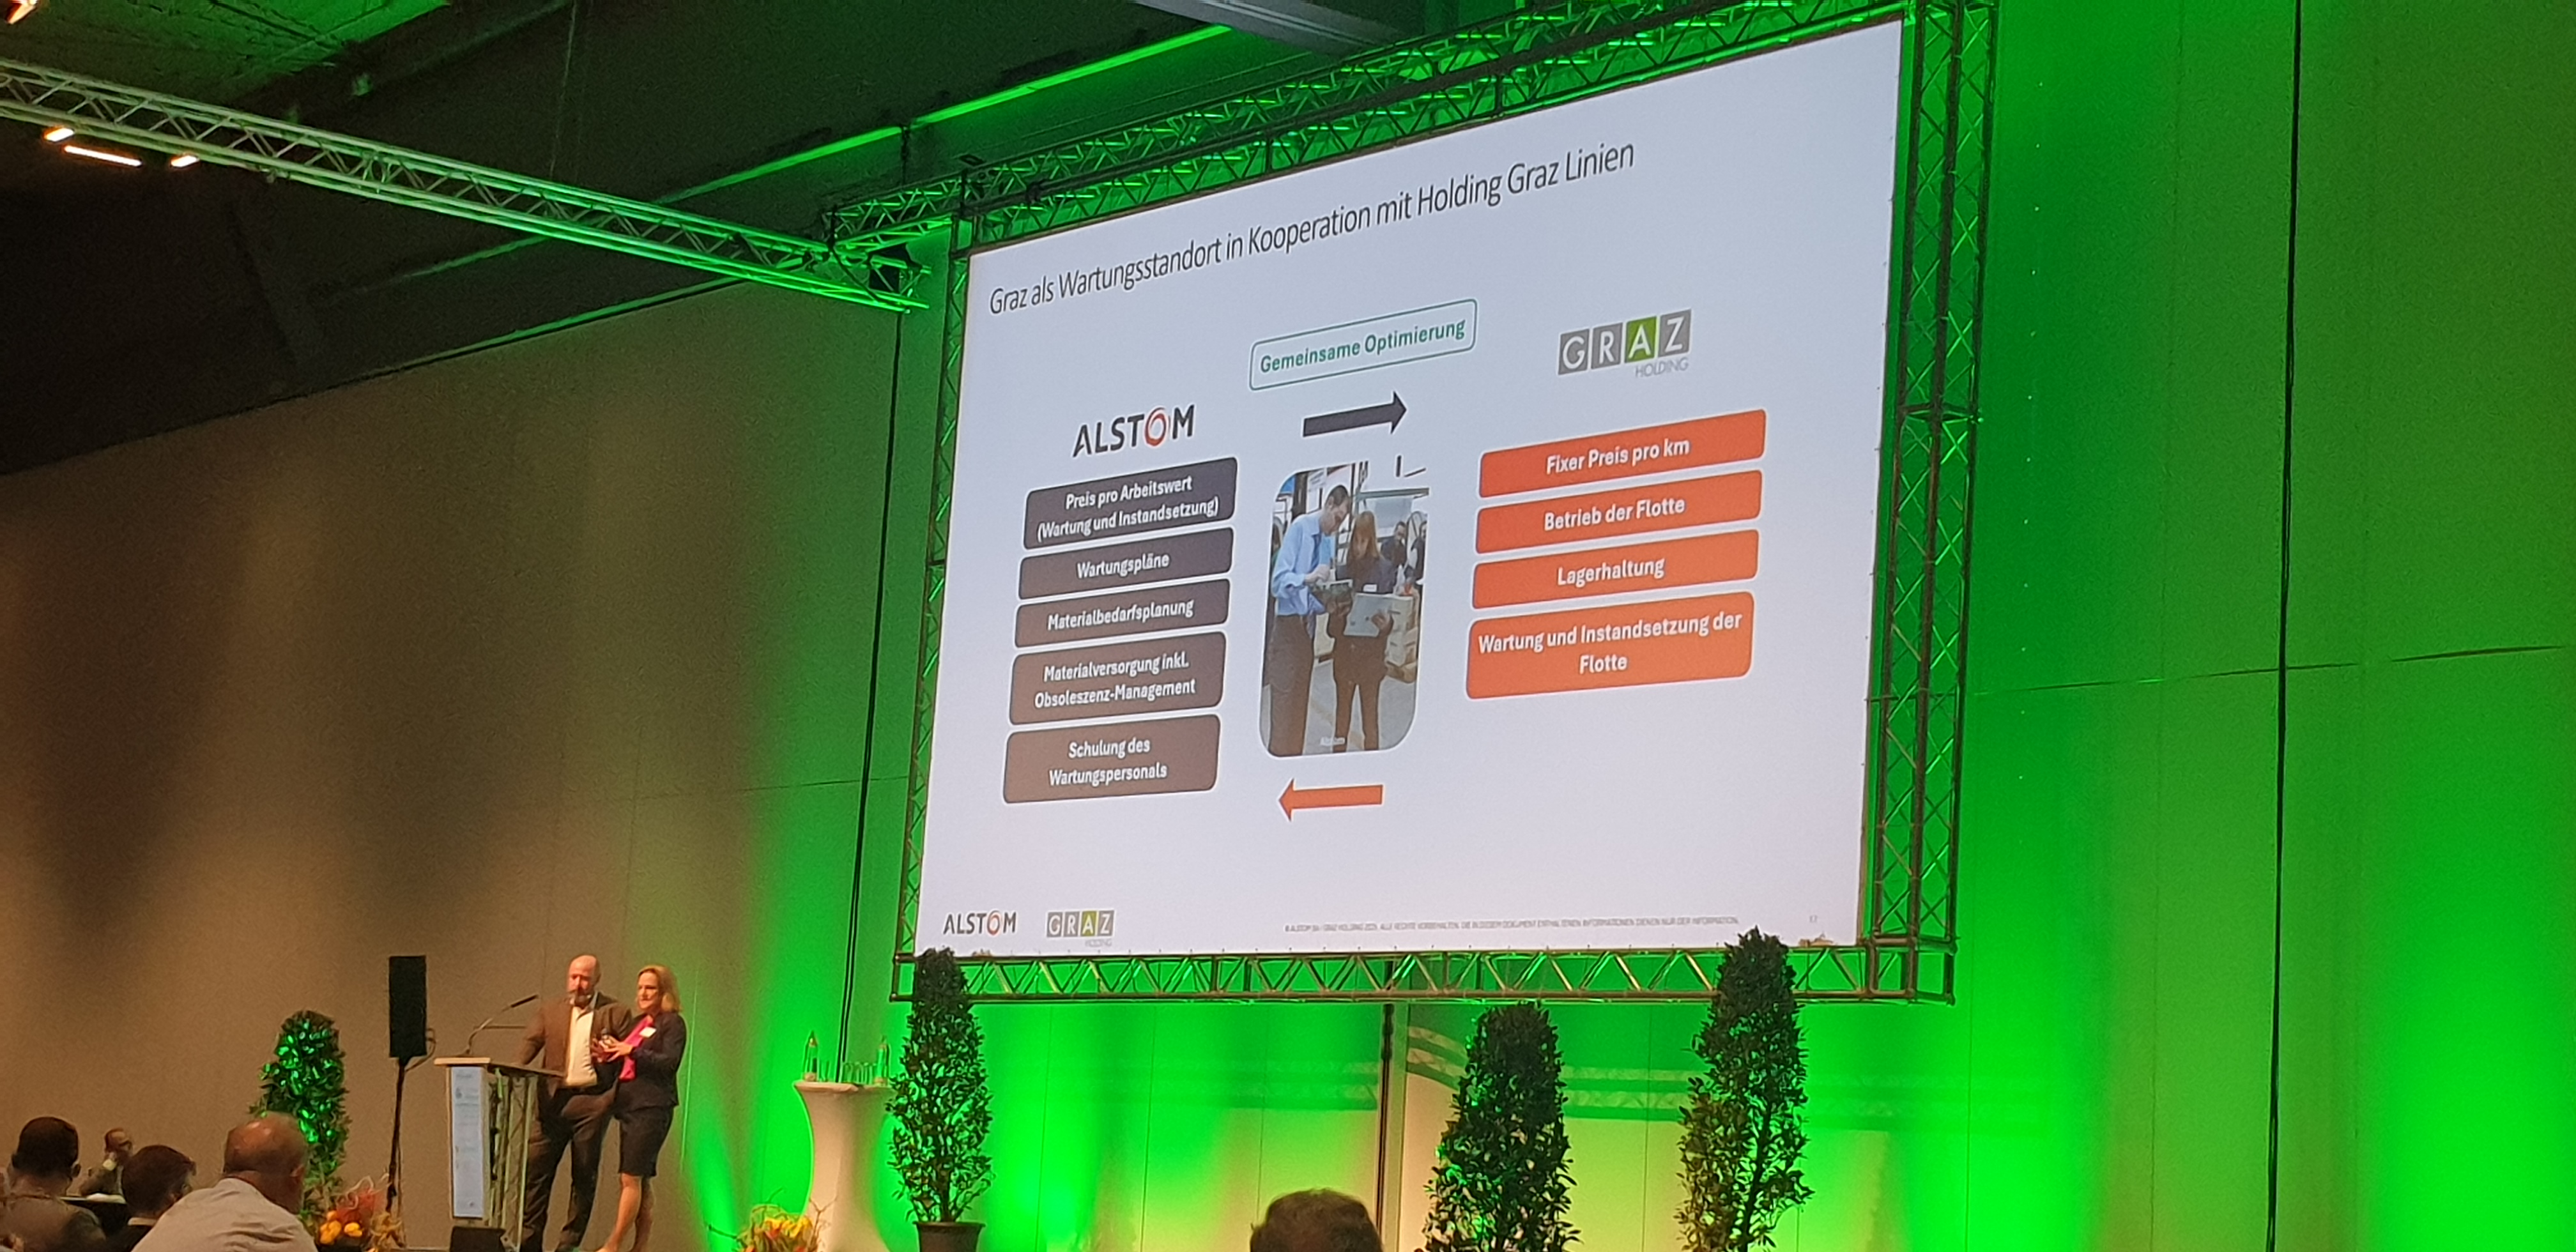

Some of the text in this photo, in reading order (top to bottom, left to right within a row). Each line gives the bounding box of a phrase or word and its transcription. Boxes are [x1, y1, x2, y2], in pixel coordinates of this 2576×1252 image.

[990, 142, 1634, 315] Graz als Wartungsstandort in Kooperation mit Holding Graz Linien
[1260, 319, 1466, 372] Gemeinsame Optimierung
[1561, 316, 1685, 370] GRAZ
[1635, 357, 1689, 378] HOLDING
[1072, 404, 1195, 458] ALSTOM
[1546, 438, 1690, 475] Fixer Preis pro km
[1065, 476, 1193, 510] Preis pro Arbeitswert
[1037, 496, 1219, 542] (Wartung und Instandsetzung)
[1544, 498, 1686, 531] Betrieb der Flotte
[1077, 553, 1170, 579] Wartungspläne
[1556, 558, 1665, 588] Lagerhaltung
[1046, 599, 1194, 631] Materialbedarfsplanung
[1478, 611, 1743, 654] Wartung und Instandsetzung der
[1043, 651, 1190, 682] Materialversorgung inkl.
[1578, 653, 1628, 675] Flotte
[1034, 678, 1197, 709] Obsoleszenz-Management
[1068, 737, 1151, 759] Schulung des
[1048, 761, 1168, 787] Wartungspersonals
[943, 909, 1017, 936] ALSTOM
[1048, 912, 1112, 936] GRAZ
